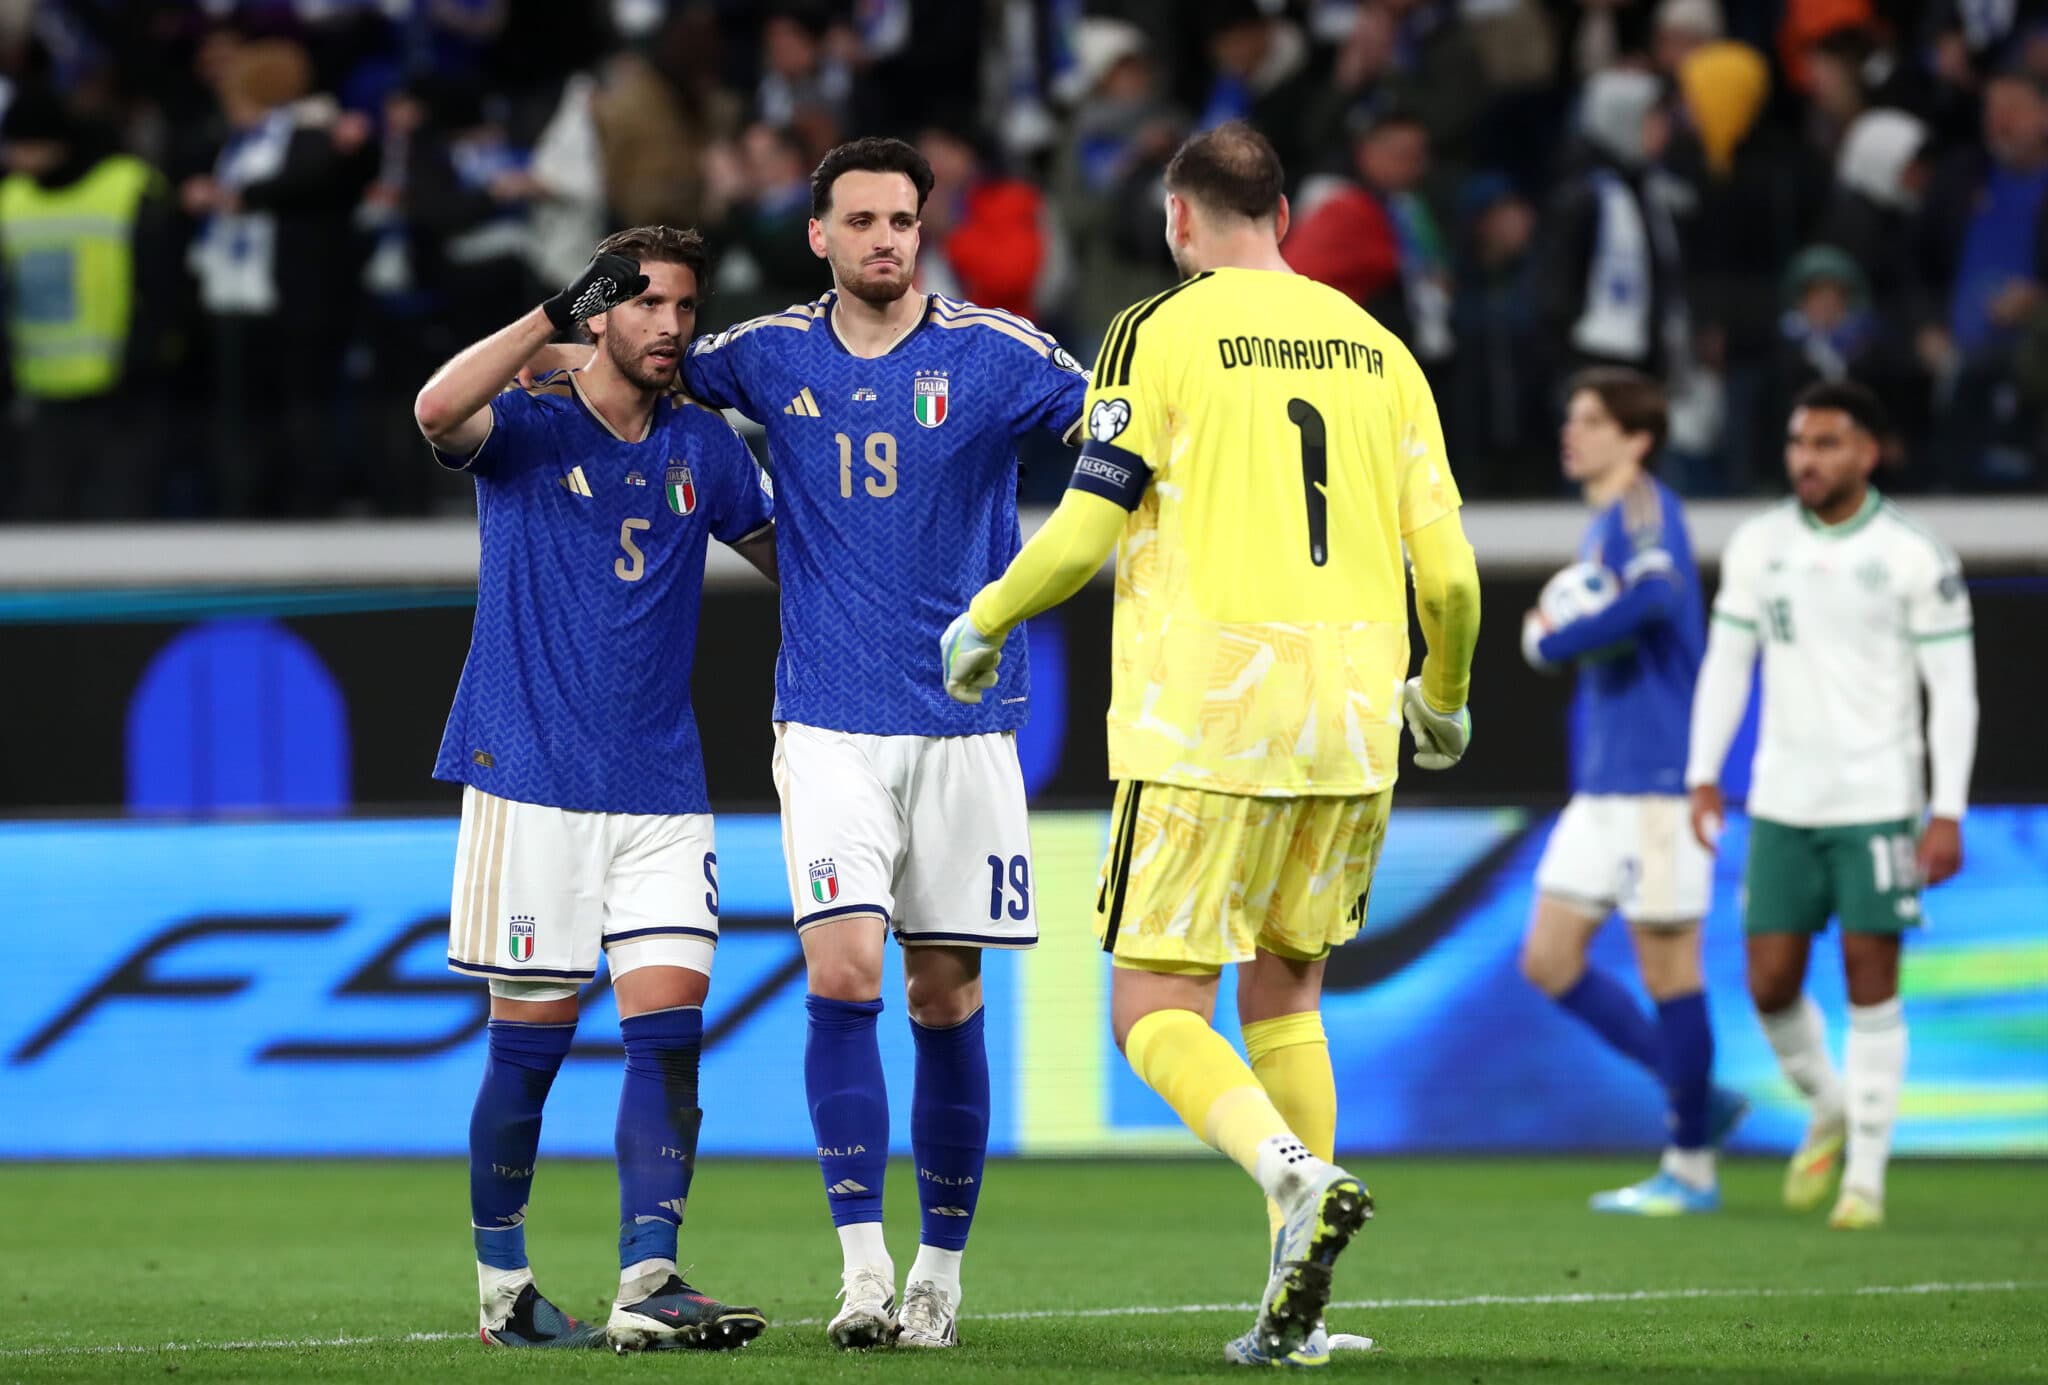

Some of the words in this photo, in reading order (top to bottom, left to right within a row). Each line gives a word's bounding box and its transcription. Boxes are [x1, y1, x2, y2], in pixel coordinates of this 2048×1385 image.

[1218, 336, 1383, 378] DONNARUMMA
[917, 381, 945, 392] ITALIA
[835, 432, 897, 498] 19
[1082, 459, 1130, 484] RESPECT
[1287, 397, 1328, 567] 1
[614, 518, 651, 582] 5
[811, 866, 834, 879] ITALIA
[987, 854, 1030, 921] 19
[511, 924, 533, 933] ITALIA
[920, 1167, 974, 1186] ITALIA
